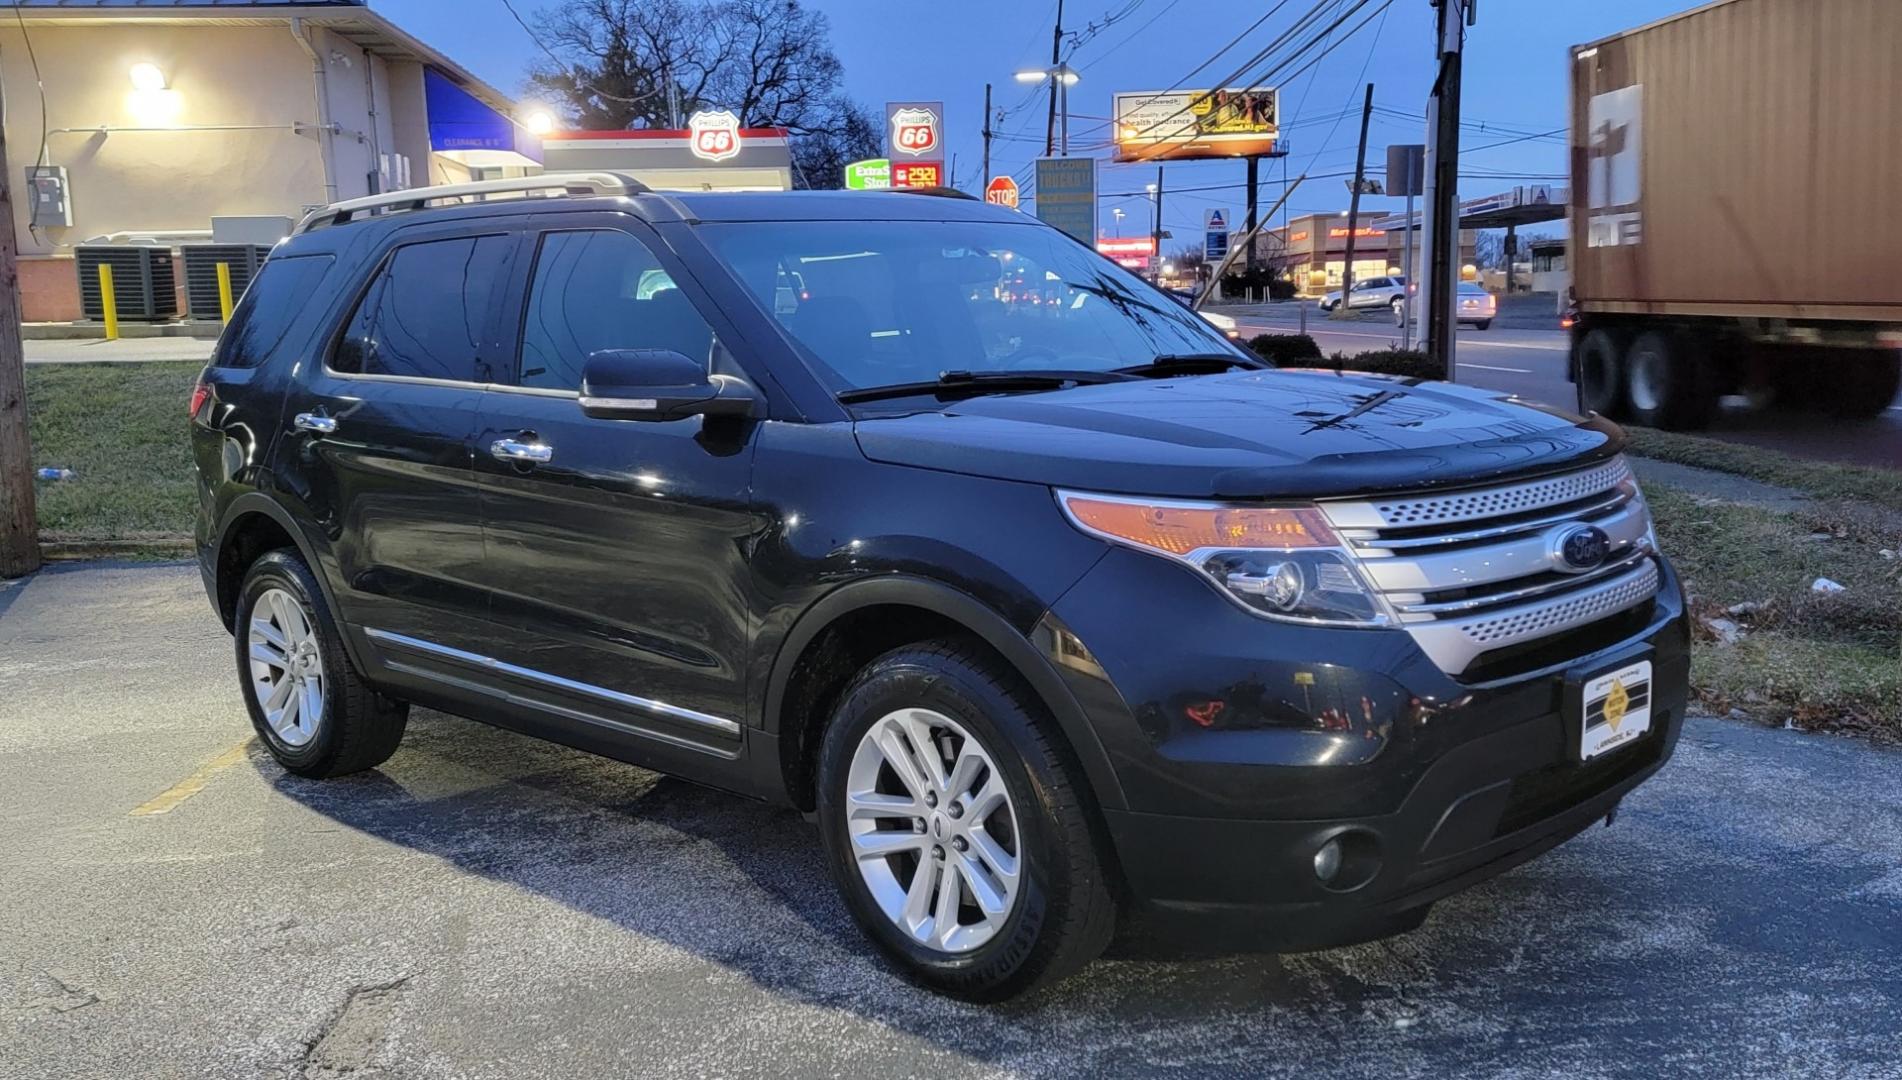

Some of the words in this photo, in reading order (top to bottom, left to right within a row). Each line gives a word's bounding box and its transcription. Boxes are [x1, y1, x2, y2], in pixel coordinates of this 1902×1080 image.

[698, 118, 730, 127] PHILLIPS
[901, 115, 931, 124] PHILLIPS
[701, 131, 730, 151] 66
[902, 127, 930, 145] 66
[988, 188, 1017, 207] STOP
[1567, 535, 1606, 560] Ford
